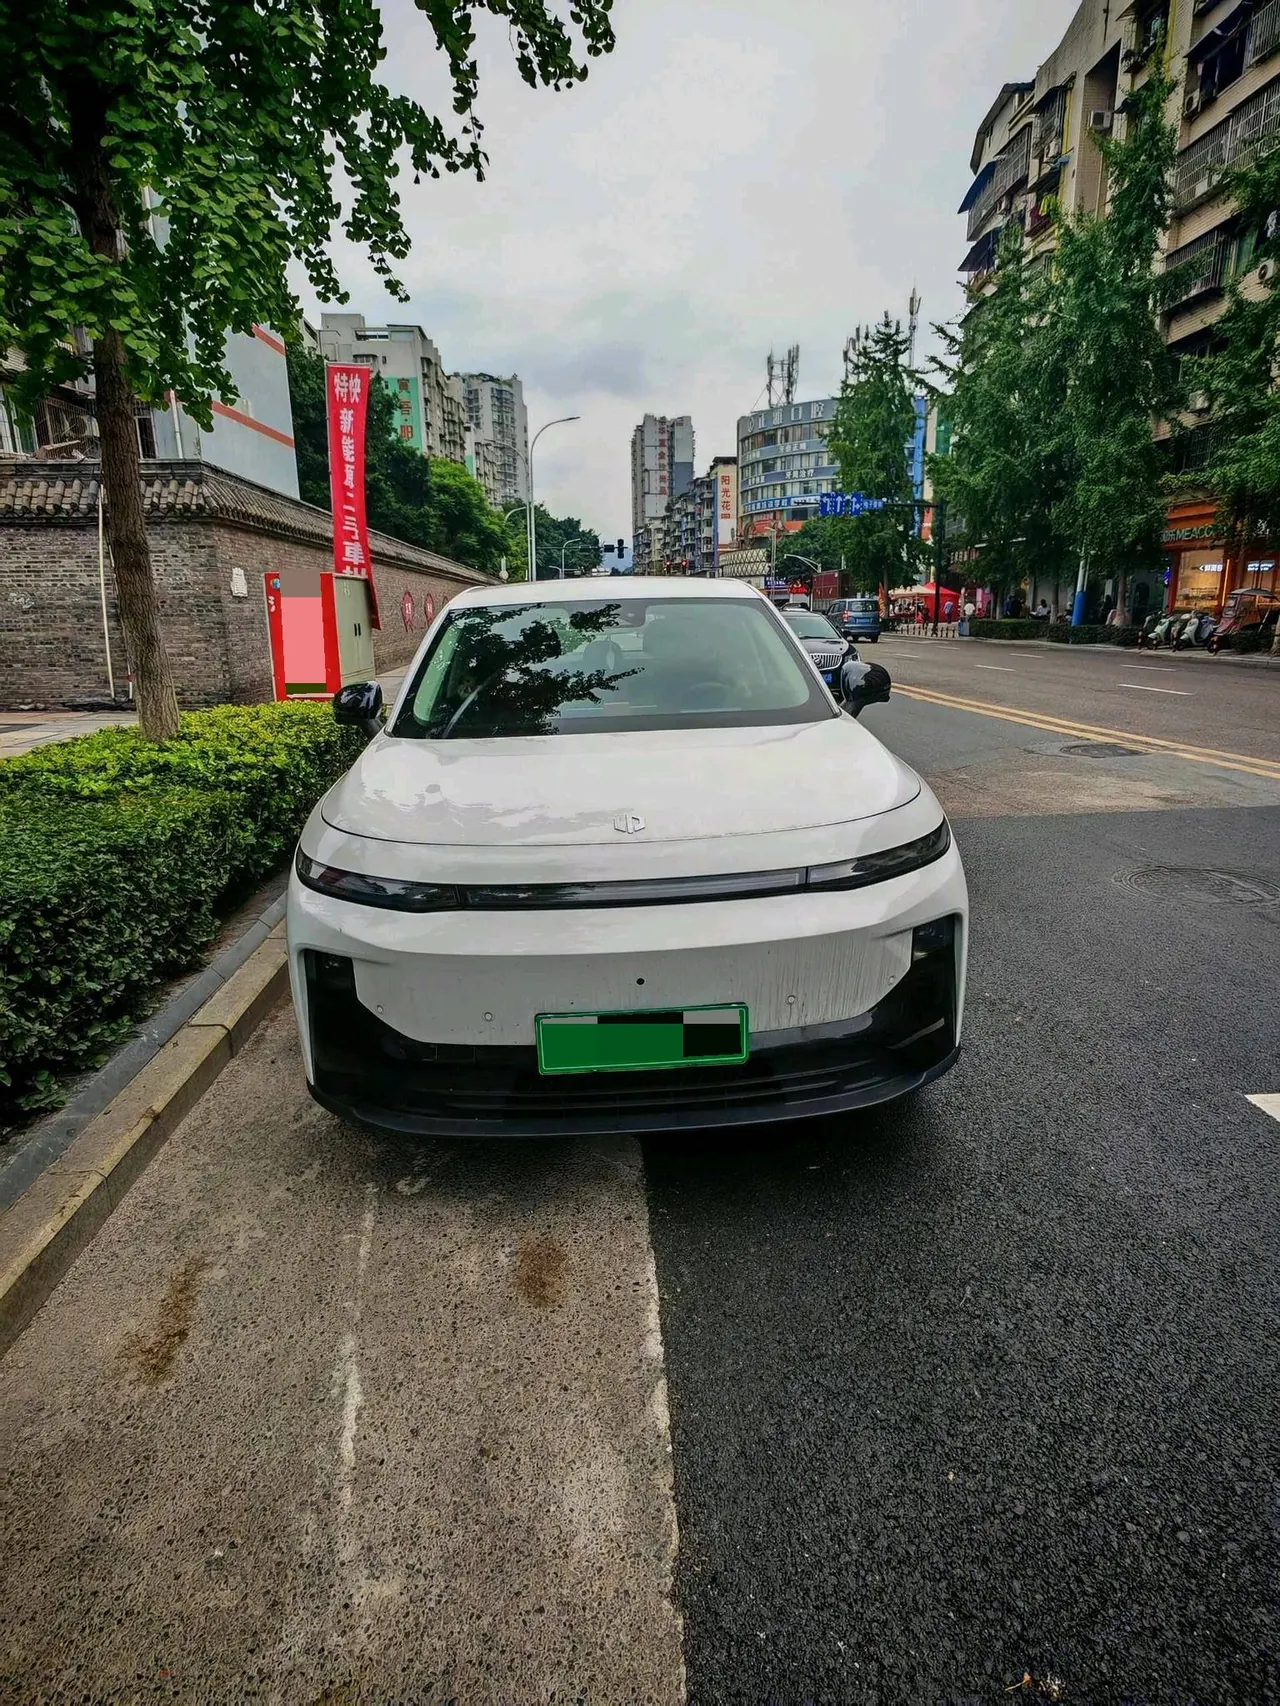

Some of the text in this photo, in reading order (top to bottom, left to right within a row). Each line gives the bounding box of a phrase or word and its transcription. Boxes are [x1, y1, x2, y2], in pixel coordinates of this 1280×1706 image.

[333, 371, 361, 404] 特快
[785, 468, 815, 480] 牙周治疗
[720, 475, 731, 520] 阳光花园
